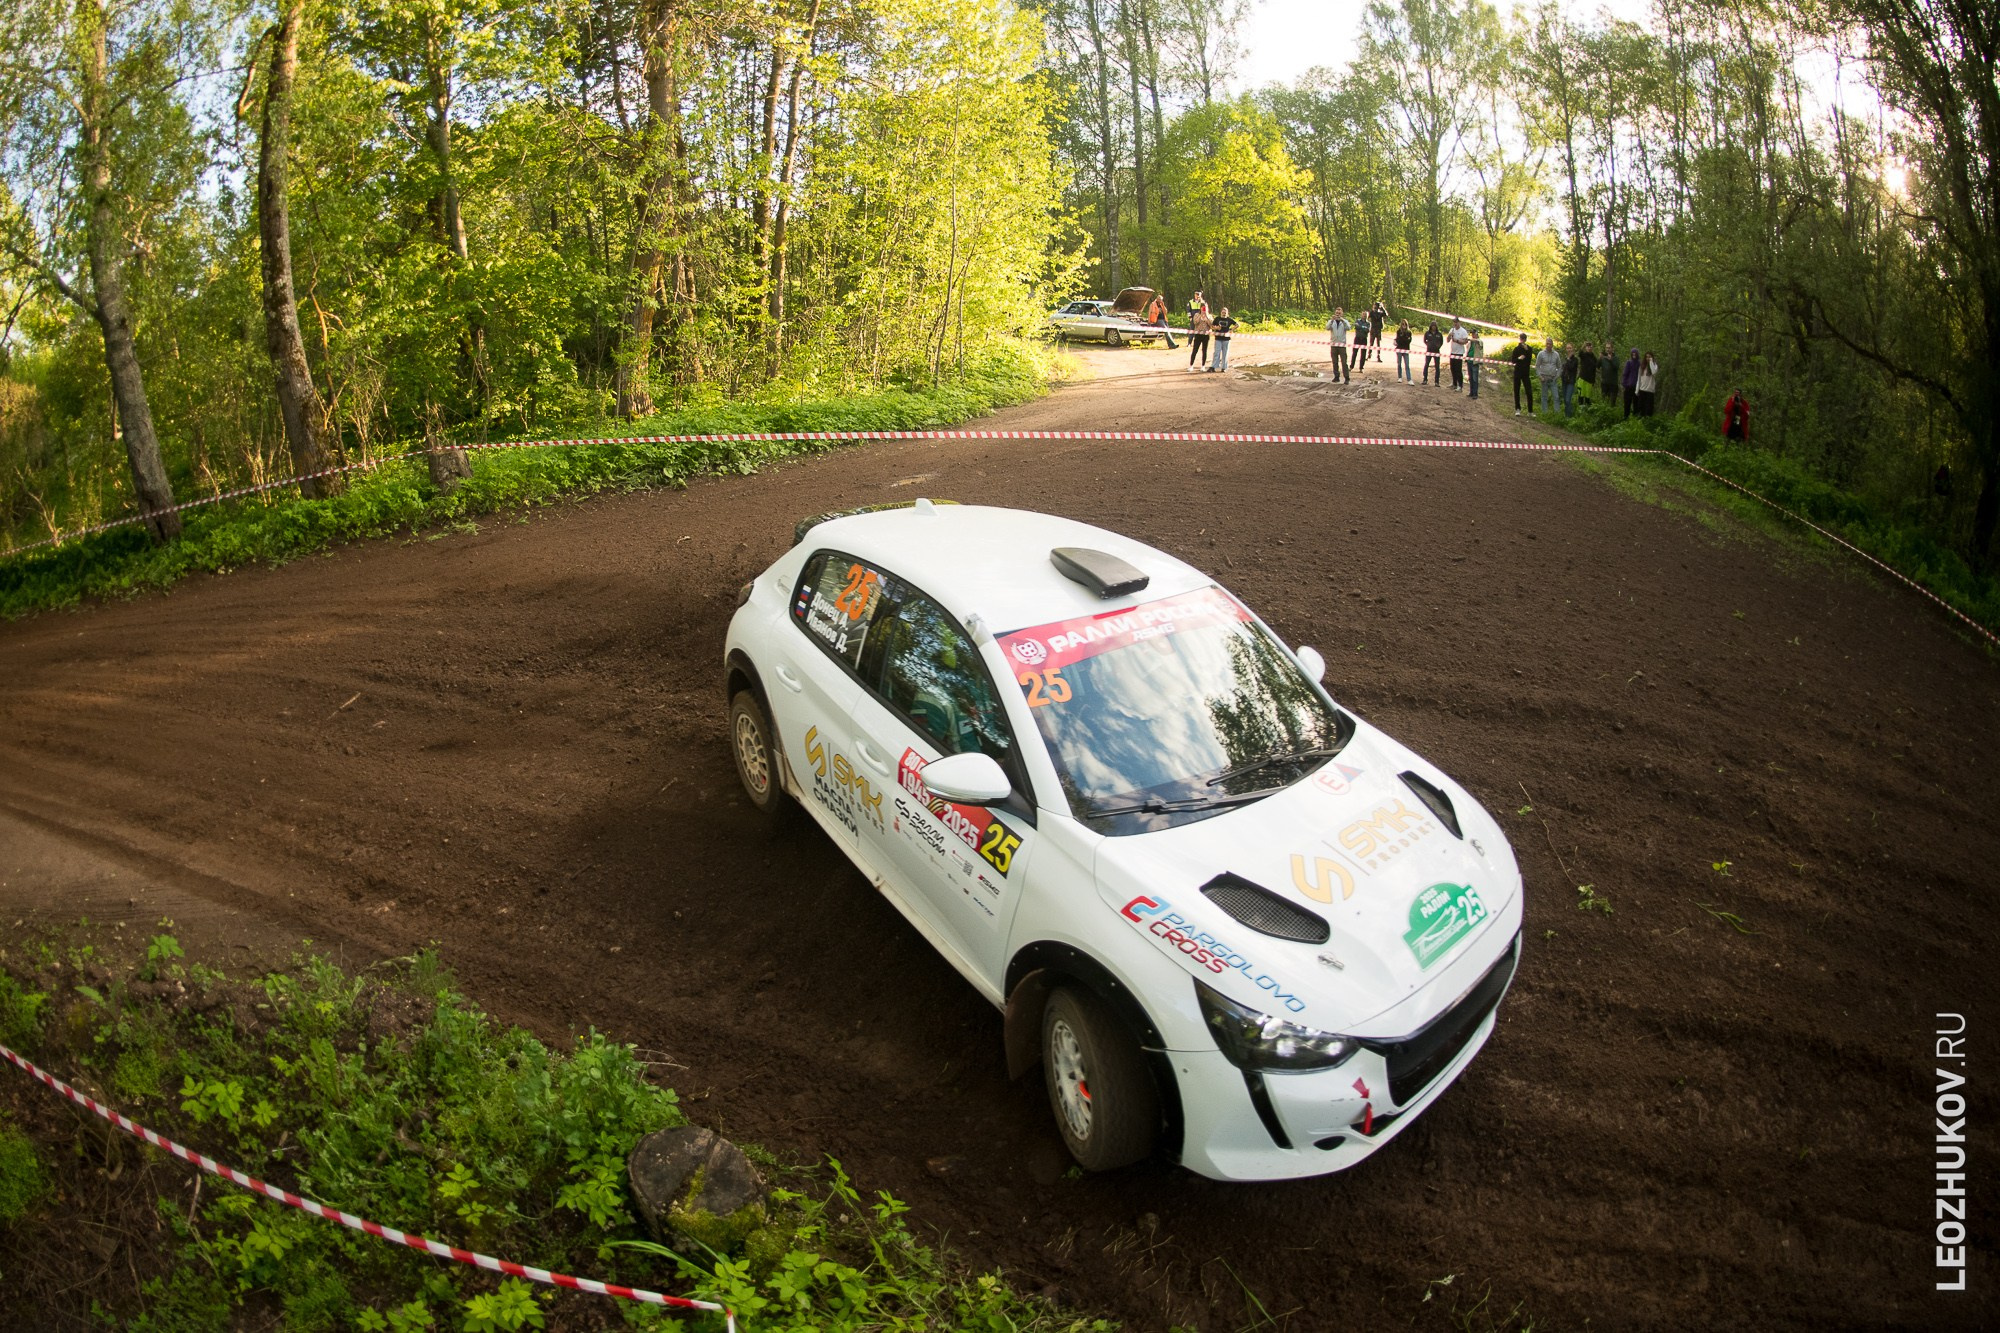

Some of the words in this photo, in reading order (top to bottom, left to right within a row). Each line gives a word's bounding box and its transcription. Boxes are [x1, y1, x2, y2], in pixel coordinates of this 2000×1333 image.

[810, 591, 840, 625] Донец
[838, 612, 849, 631] А.
[835, 563, 877, 620] 25
[806, 609, 838, 643] Иванов
[1047, 613, 1138, 654] РАЛЛИ
[1018, 667, 1073, 708] 25
[904, 751, 920, 771] 80
[833, 753, 884, 824] SMK
[902, 768, 931, 807] 1945
[909, 819, 946, 857] РОССИИ
[912, 812, 945, 844] РАЛЛИ
[942, 803, 980, 850] 2025
[1338, 798, 1424, 860] SMK
[979, 823, 1021, 873] 25
[1420, 890, 1451, 918] РАЛЛИ
[1457, 888, 1486, 926] 25
[1149, 920, 1230, 974] CROSS
[1161, 912, 1306, 1013] PARGOLOVO
